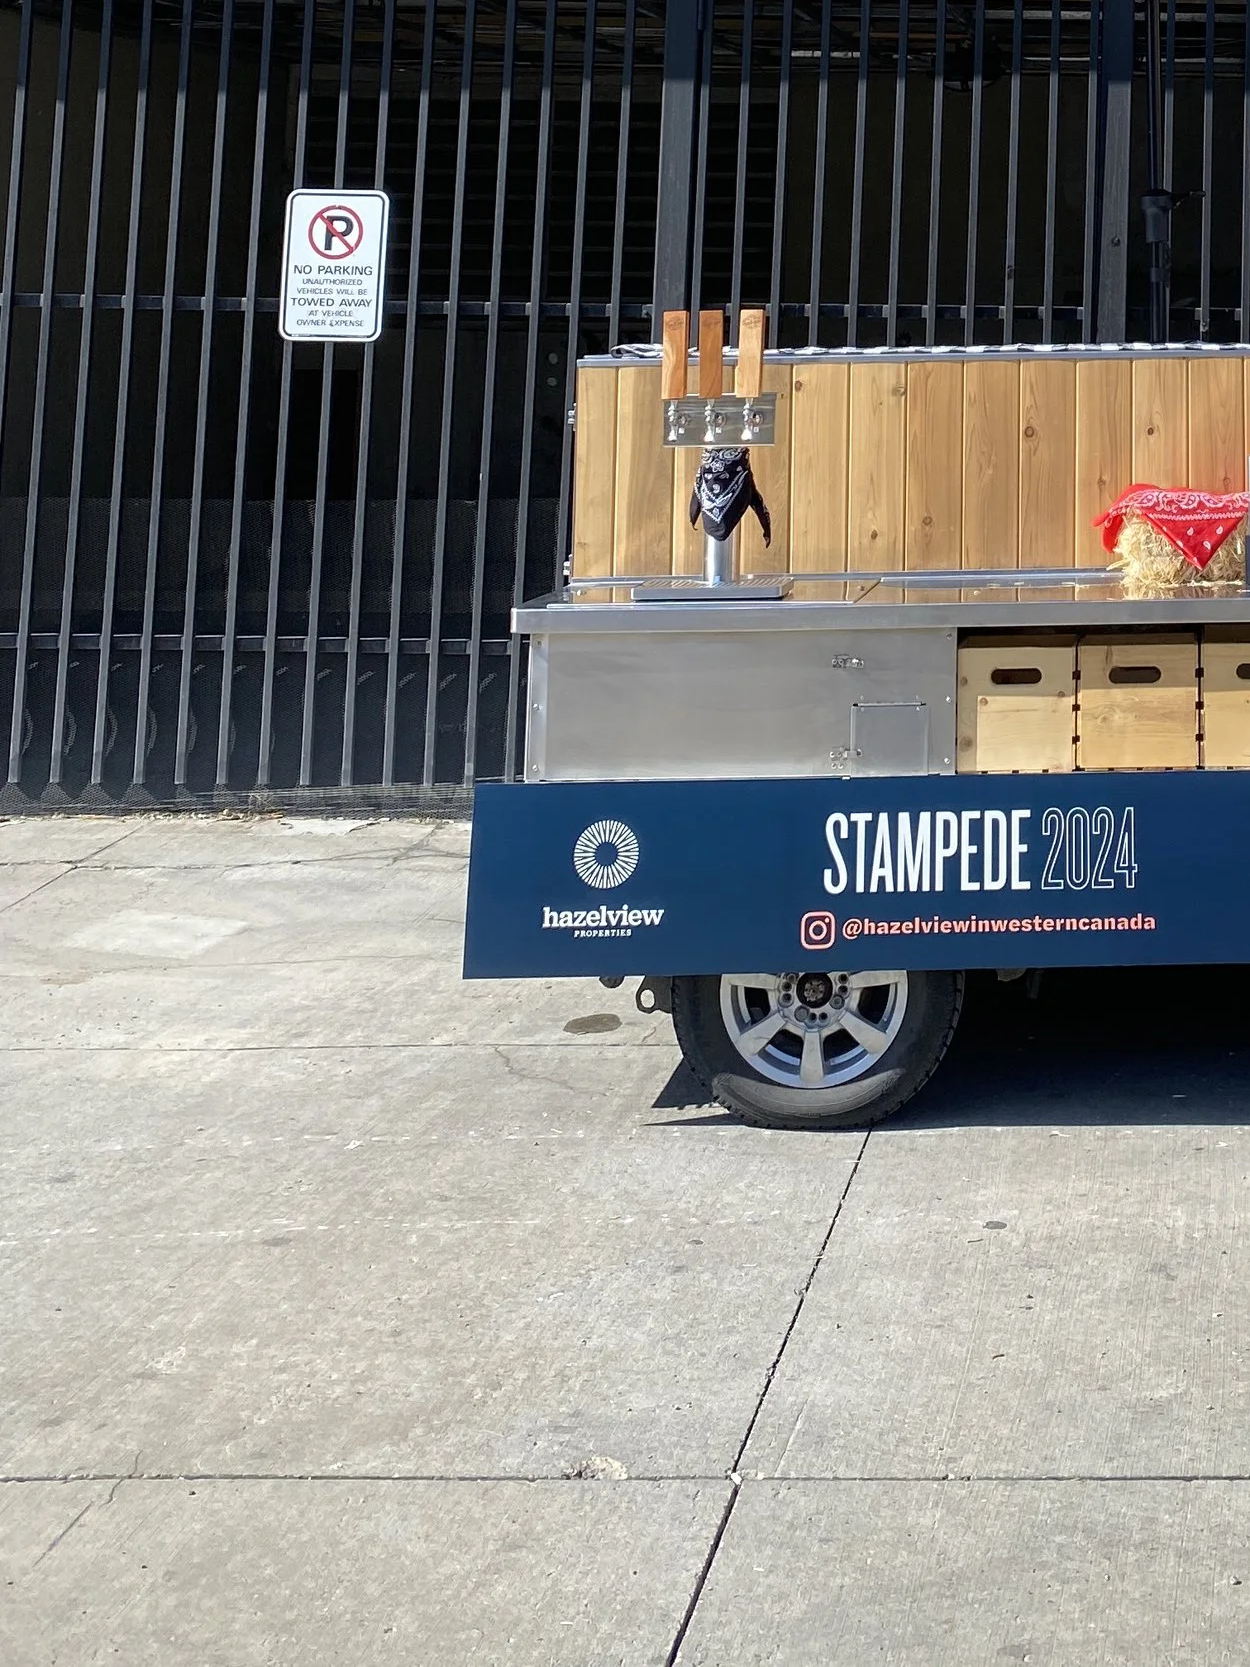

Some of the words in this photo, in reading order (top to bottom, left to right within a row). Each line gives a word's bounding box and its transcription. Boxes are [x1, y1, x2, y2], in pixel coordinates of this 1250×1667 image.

[293, 264, 313, 275] NO
[317, 265, 373, 276] PARKING
[290, 297, 335, 307] TOWED
[338, 298, 373, 307] AWAY
[823, 809, 1031, 894] STAMPEDE
[1041, 806, 1138, 892] 2024
[541, 904, 665, 929] hazelview
[573, 928, 632, 938] PROPERTIES
[841, 913, 1156, 940] @hazelviewinwesterncanada
